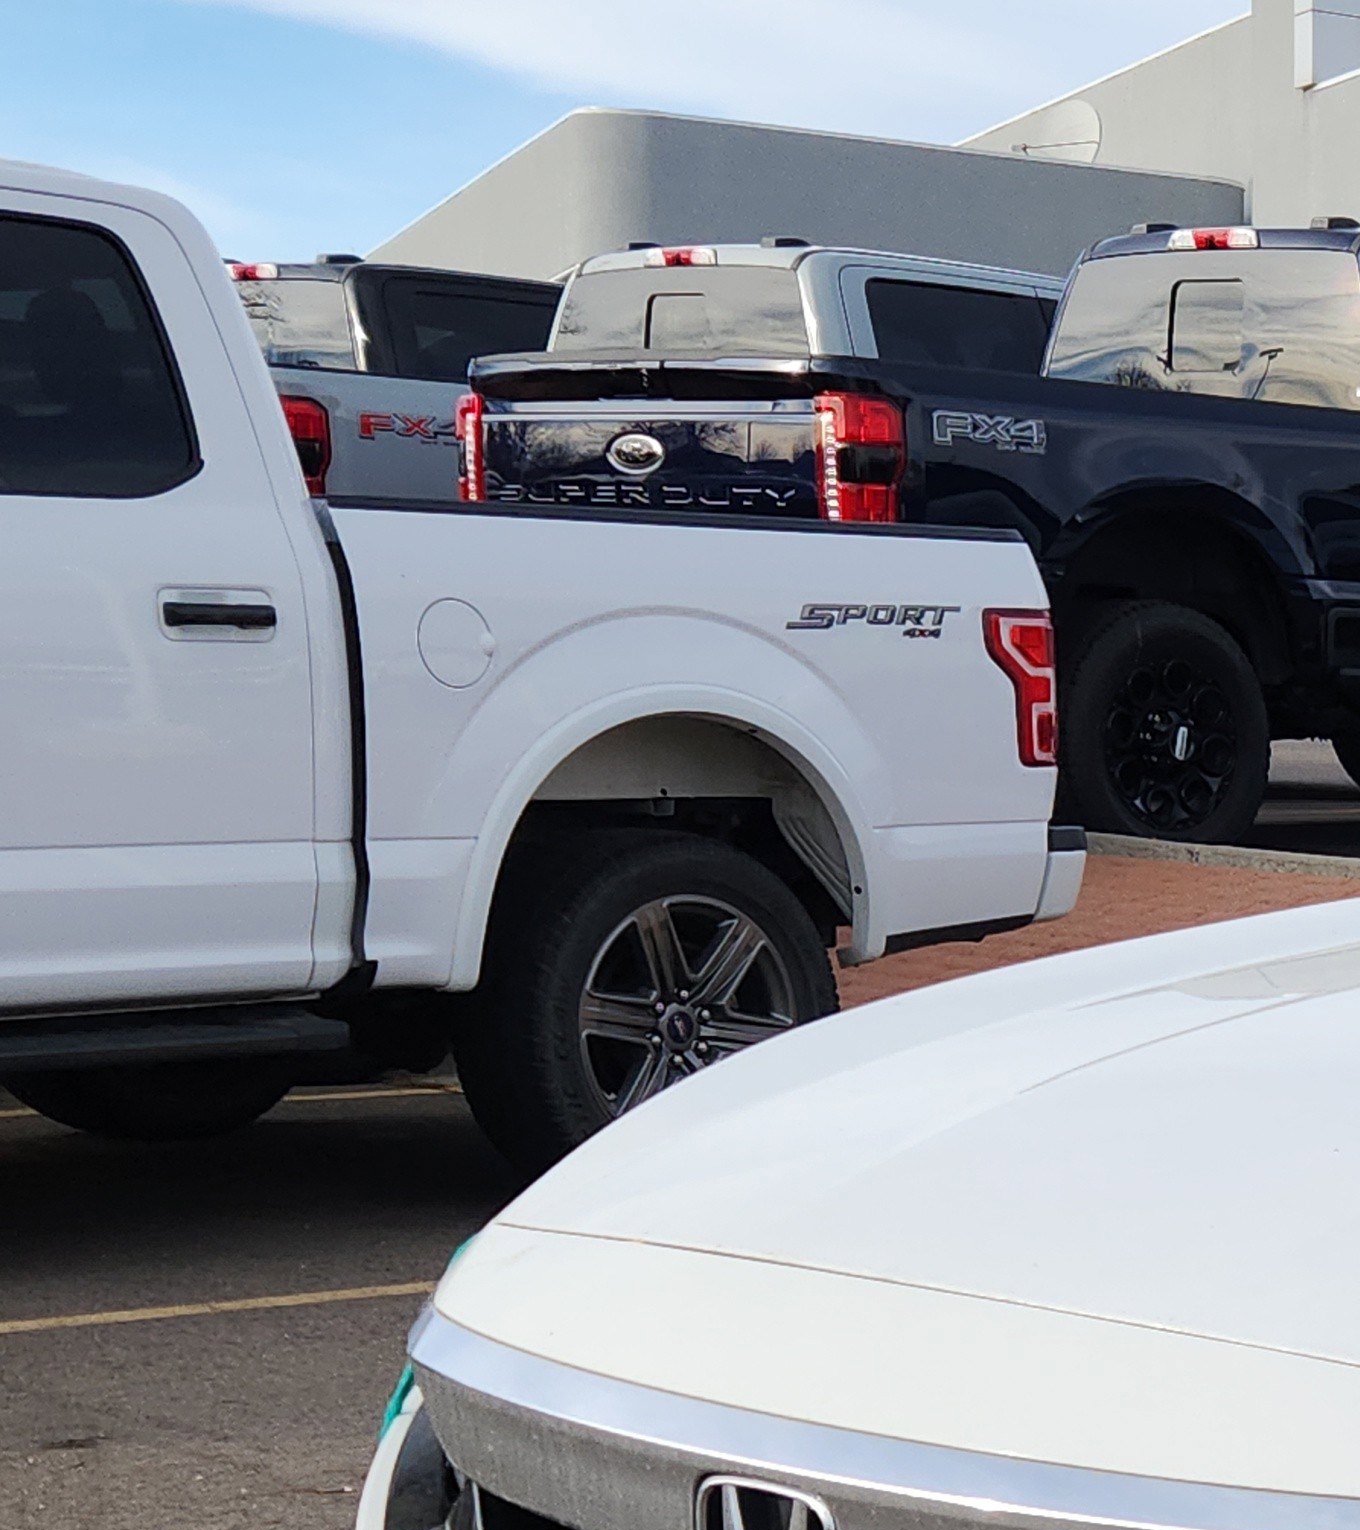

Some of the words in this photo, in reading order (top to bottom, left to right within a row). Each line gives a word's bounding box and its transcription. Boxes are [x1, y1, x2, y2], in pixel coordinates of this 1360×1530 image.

[932, 409, 1046, 446] FX4
[498, 484, 649, 504] SUPER
[662, 486, 796, 506] DUTY
[785, 604, 961, 630] SPORT
